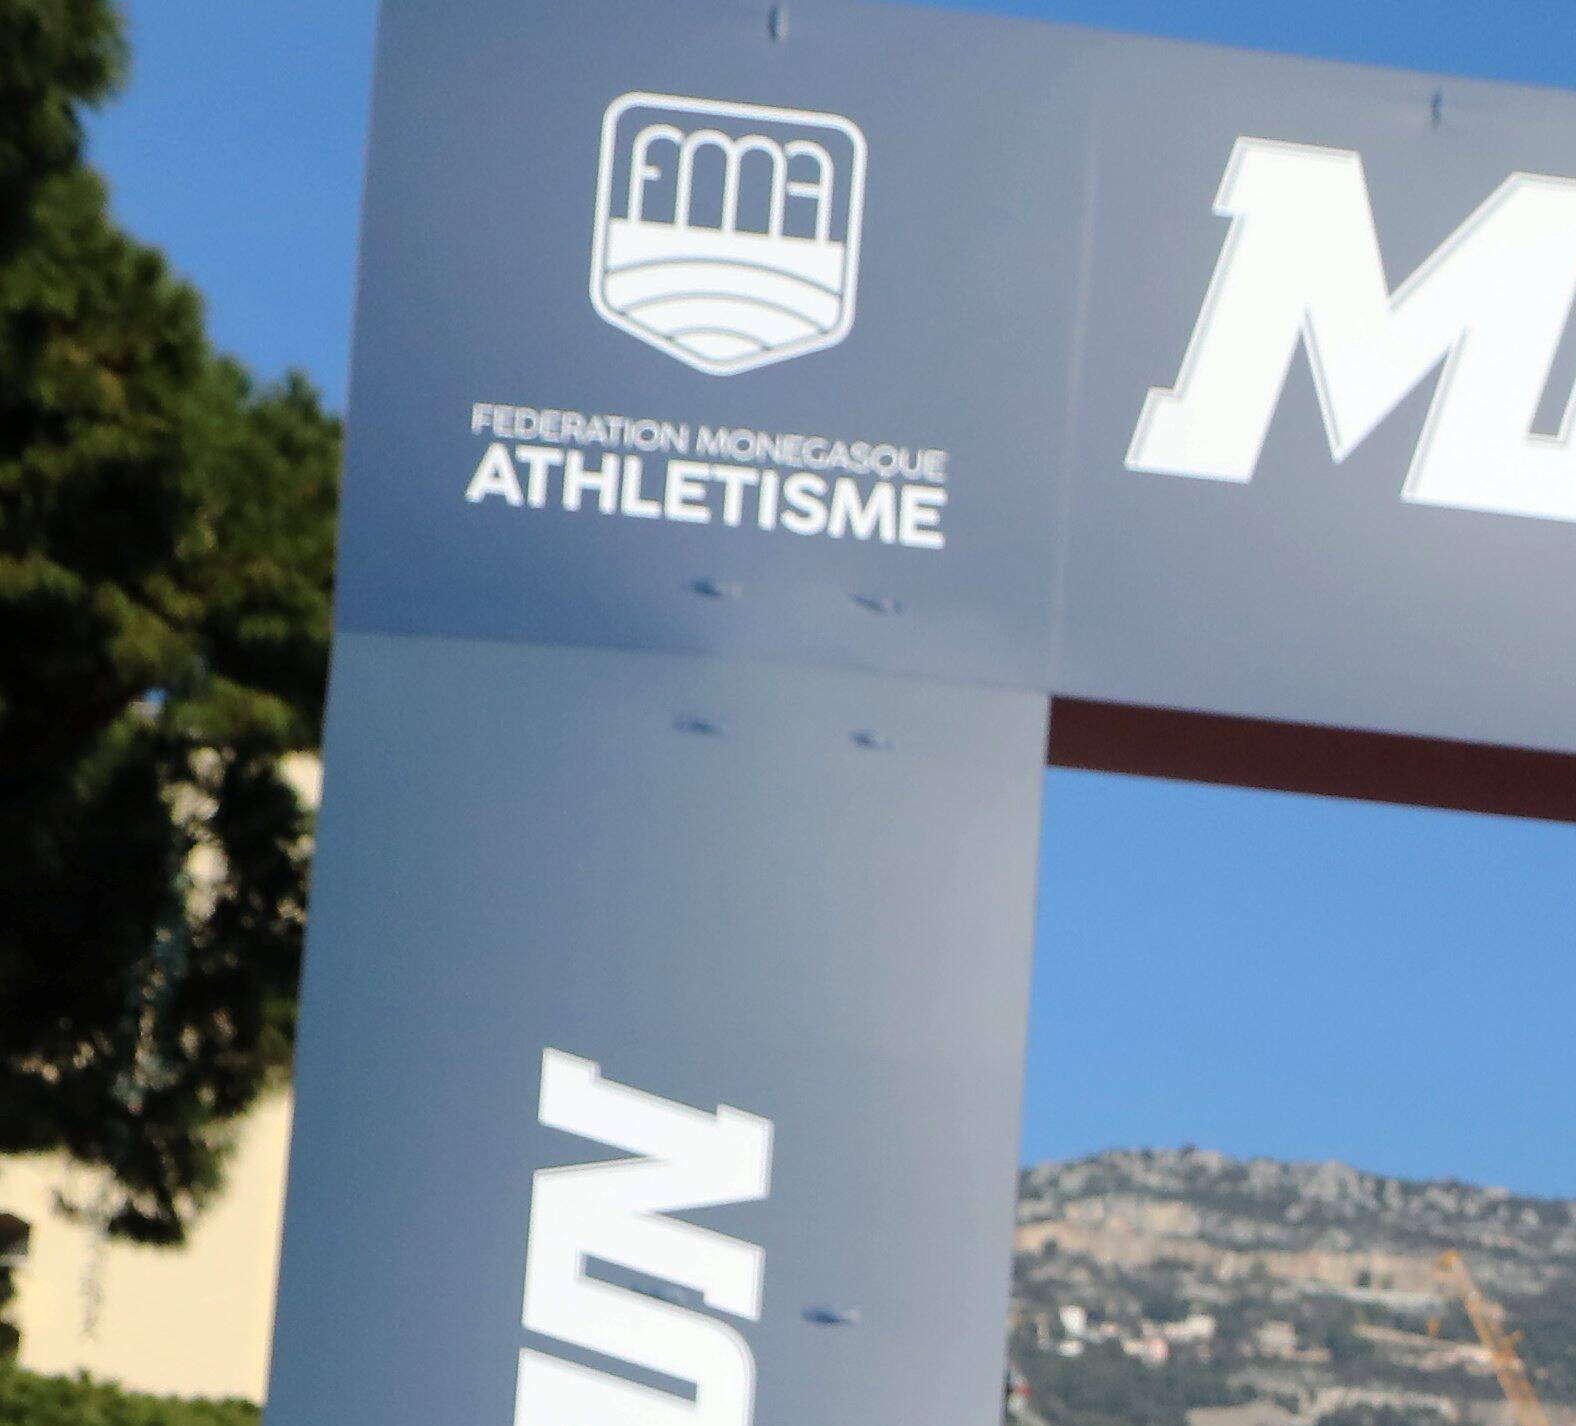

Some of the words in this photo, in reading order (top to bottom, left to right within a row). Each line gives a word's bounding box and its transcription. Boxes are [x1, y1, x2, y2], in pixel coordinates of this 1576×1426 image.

[471, 402, 689, 454] FEDERATION
[695, 426, 950, 482] MONEGASQUE
[466, 443, 948, 550] ATHLETISME
